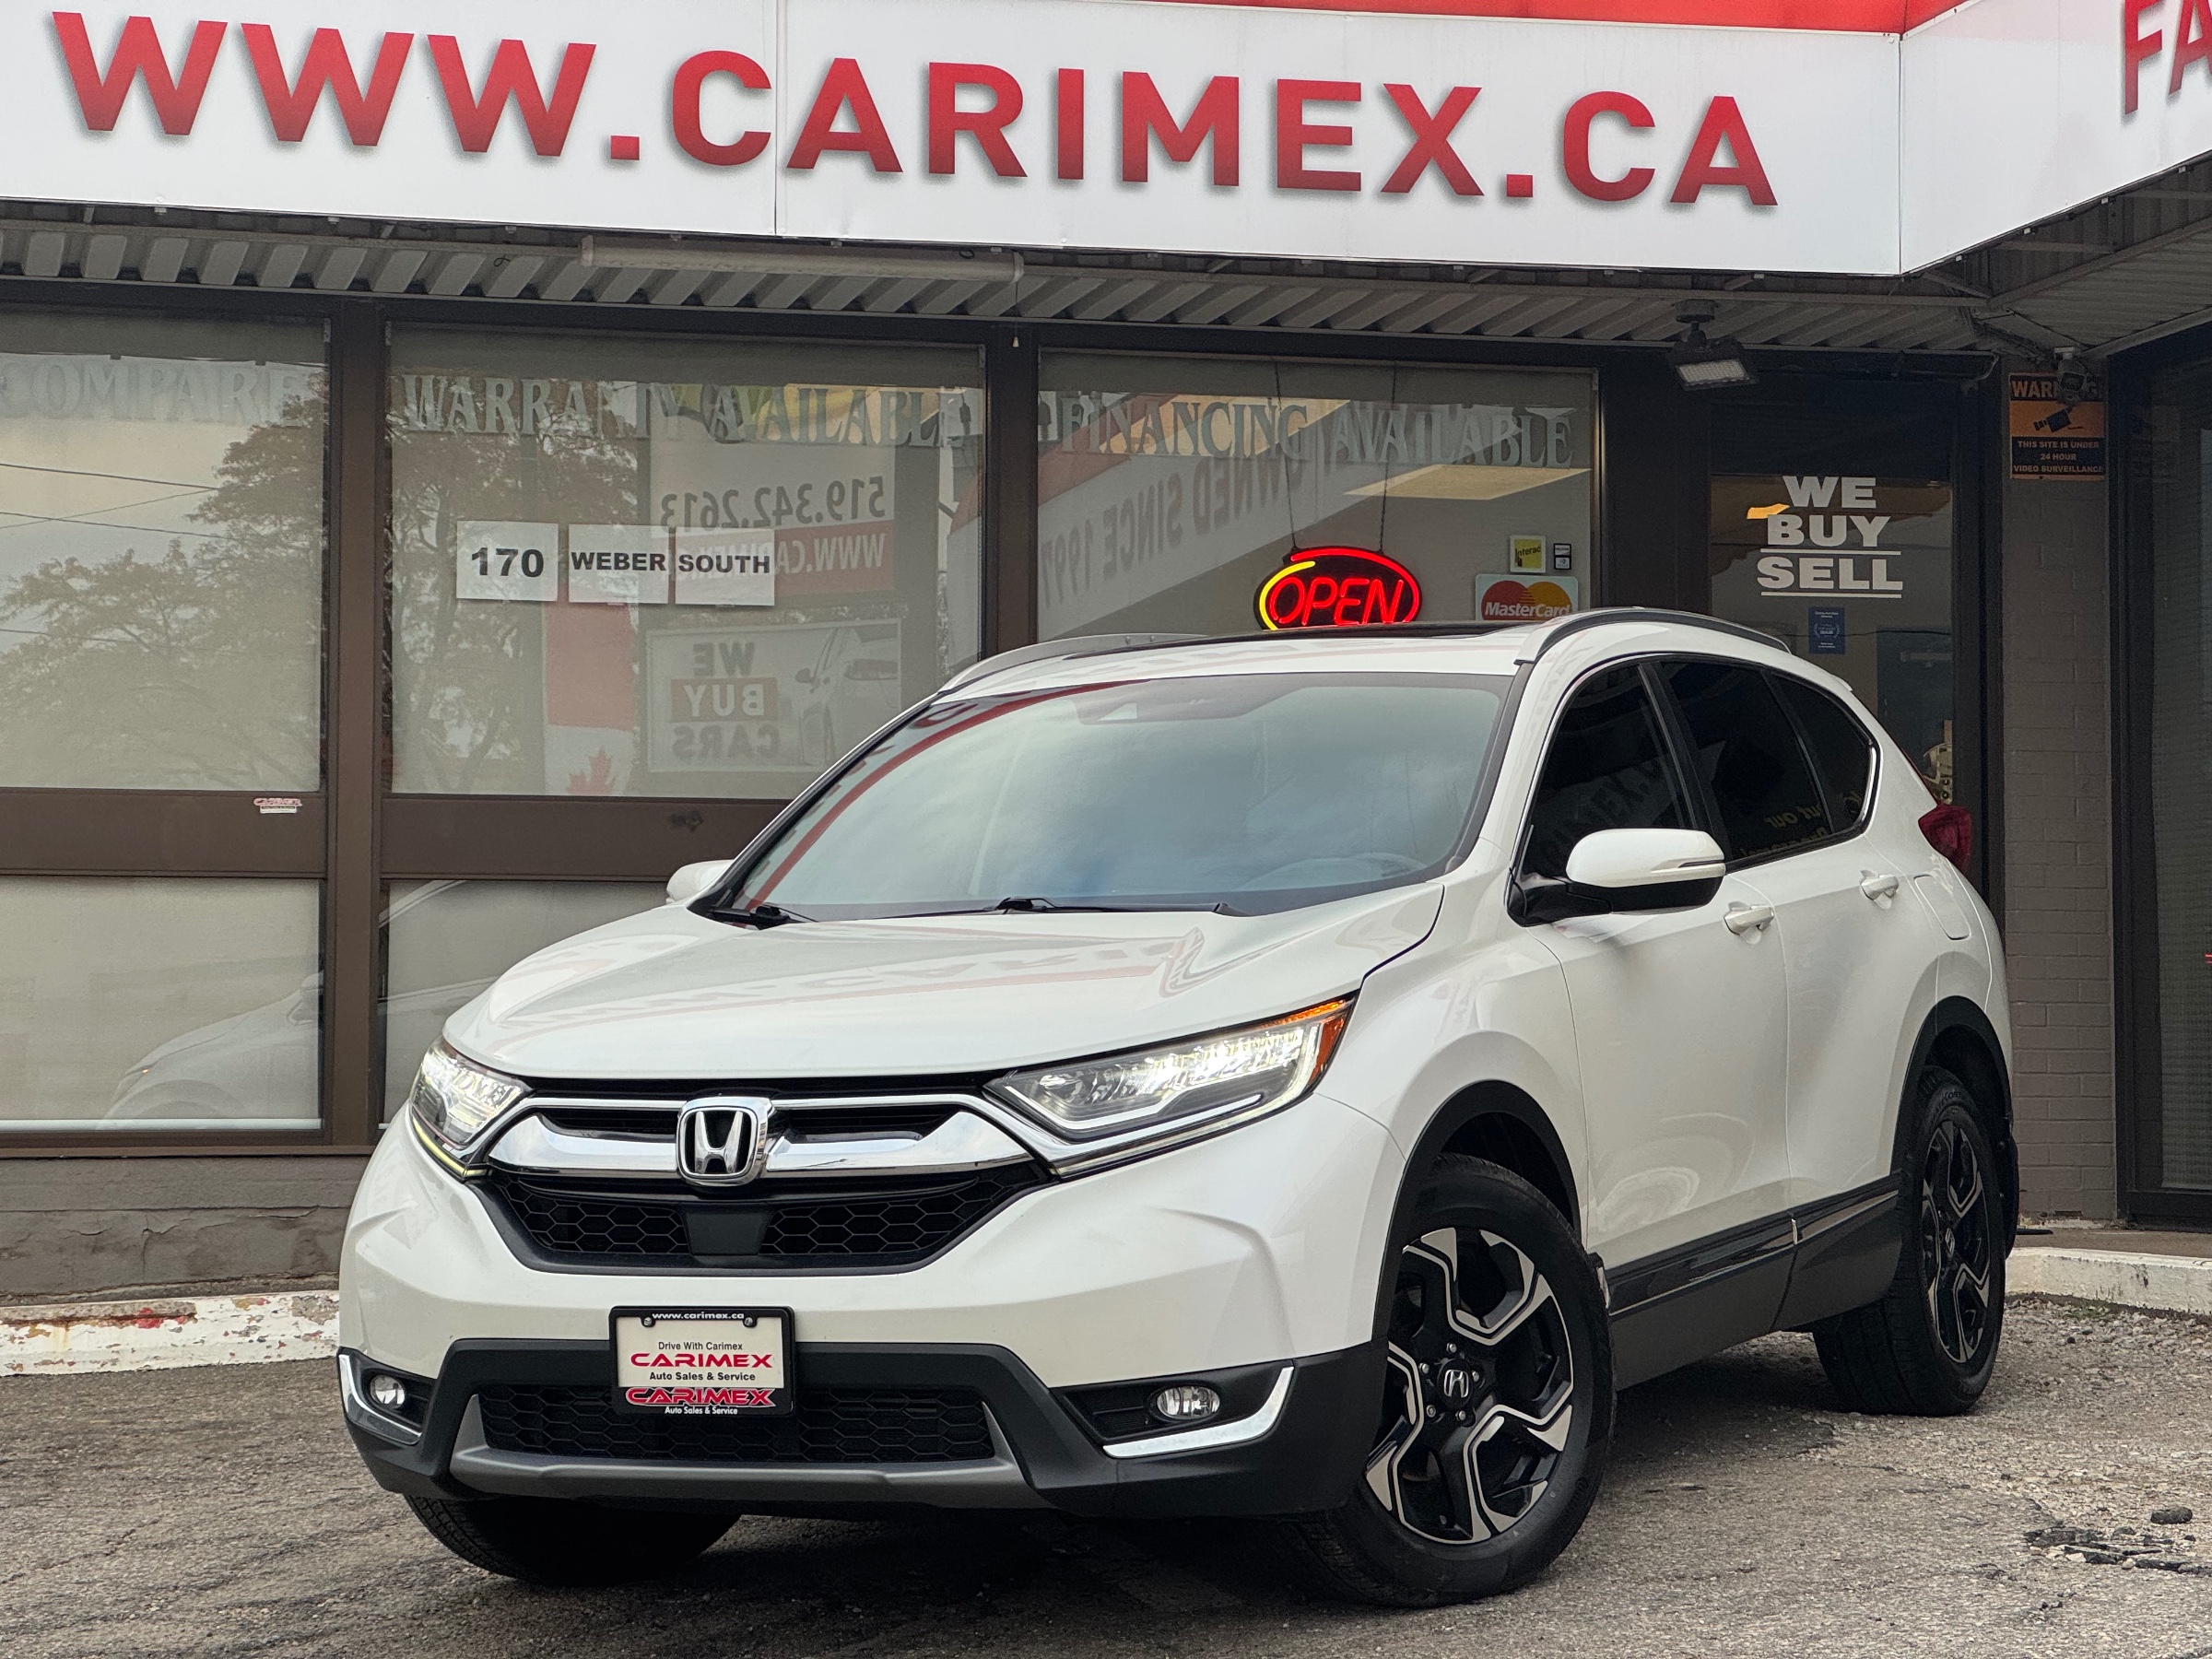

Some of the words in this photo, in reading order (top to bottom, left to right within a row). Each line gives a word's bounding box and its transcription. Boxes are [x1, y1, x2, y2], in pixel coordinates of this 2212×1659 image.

[52, 11, 1778, 206] WWW.CARIMEX.CA
[1061, 397, 1308, 460] FINANCING
[1331, 406, 1573, 469] AVAILABLE
[2040, 441, 2058, 449] SITE
[2071, 441, 2100, 449] UNDER
[2040, 453, 2051, 461] 24
[2053, 453, 2077, 461] HOUR
[2013, 465, 2039, 473] VIDEO
[2041, 465, 2104, 474] SURVEILLANCE
[1783, 476, 1877, 508] WE
[1767, 514, 1891, 547] BUY
[471, 547, 545, 578] 170
[571, 551, 667, 571] WEBER
[677, 553, 771, 574] SOUTH
[1757, 556, 1903, 591] SELL
[1268, 575, 1405, 627] OPEN
[1484, 601, 1571, 618] MasterCard
[652, 1312, 745, 1320] www.carimex.ca
[658, 1341, 681, 1350] Drive
[683, 1341, 703, 1350] With
[705, 1341, 743, 1350] Carimex
[630, 1353, 773, 1368] CARIMEX
[649, 1371, 673, 1381] Auto
[676, 1371, 704, 1381] Sales
[707, 1372, 715, 1381] &
[717, 1371, 756, 1381] Service
[626, 1387, 776, 1406] CARIMEX
[665, 1406, 683, 1415] Auto
[684, 1406, 703, 1415] Sales
[705, 1406, 711, 1415] &
[712, 1406, 738, 1415] Service
